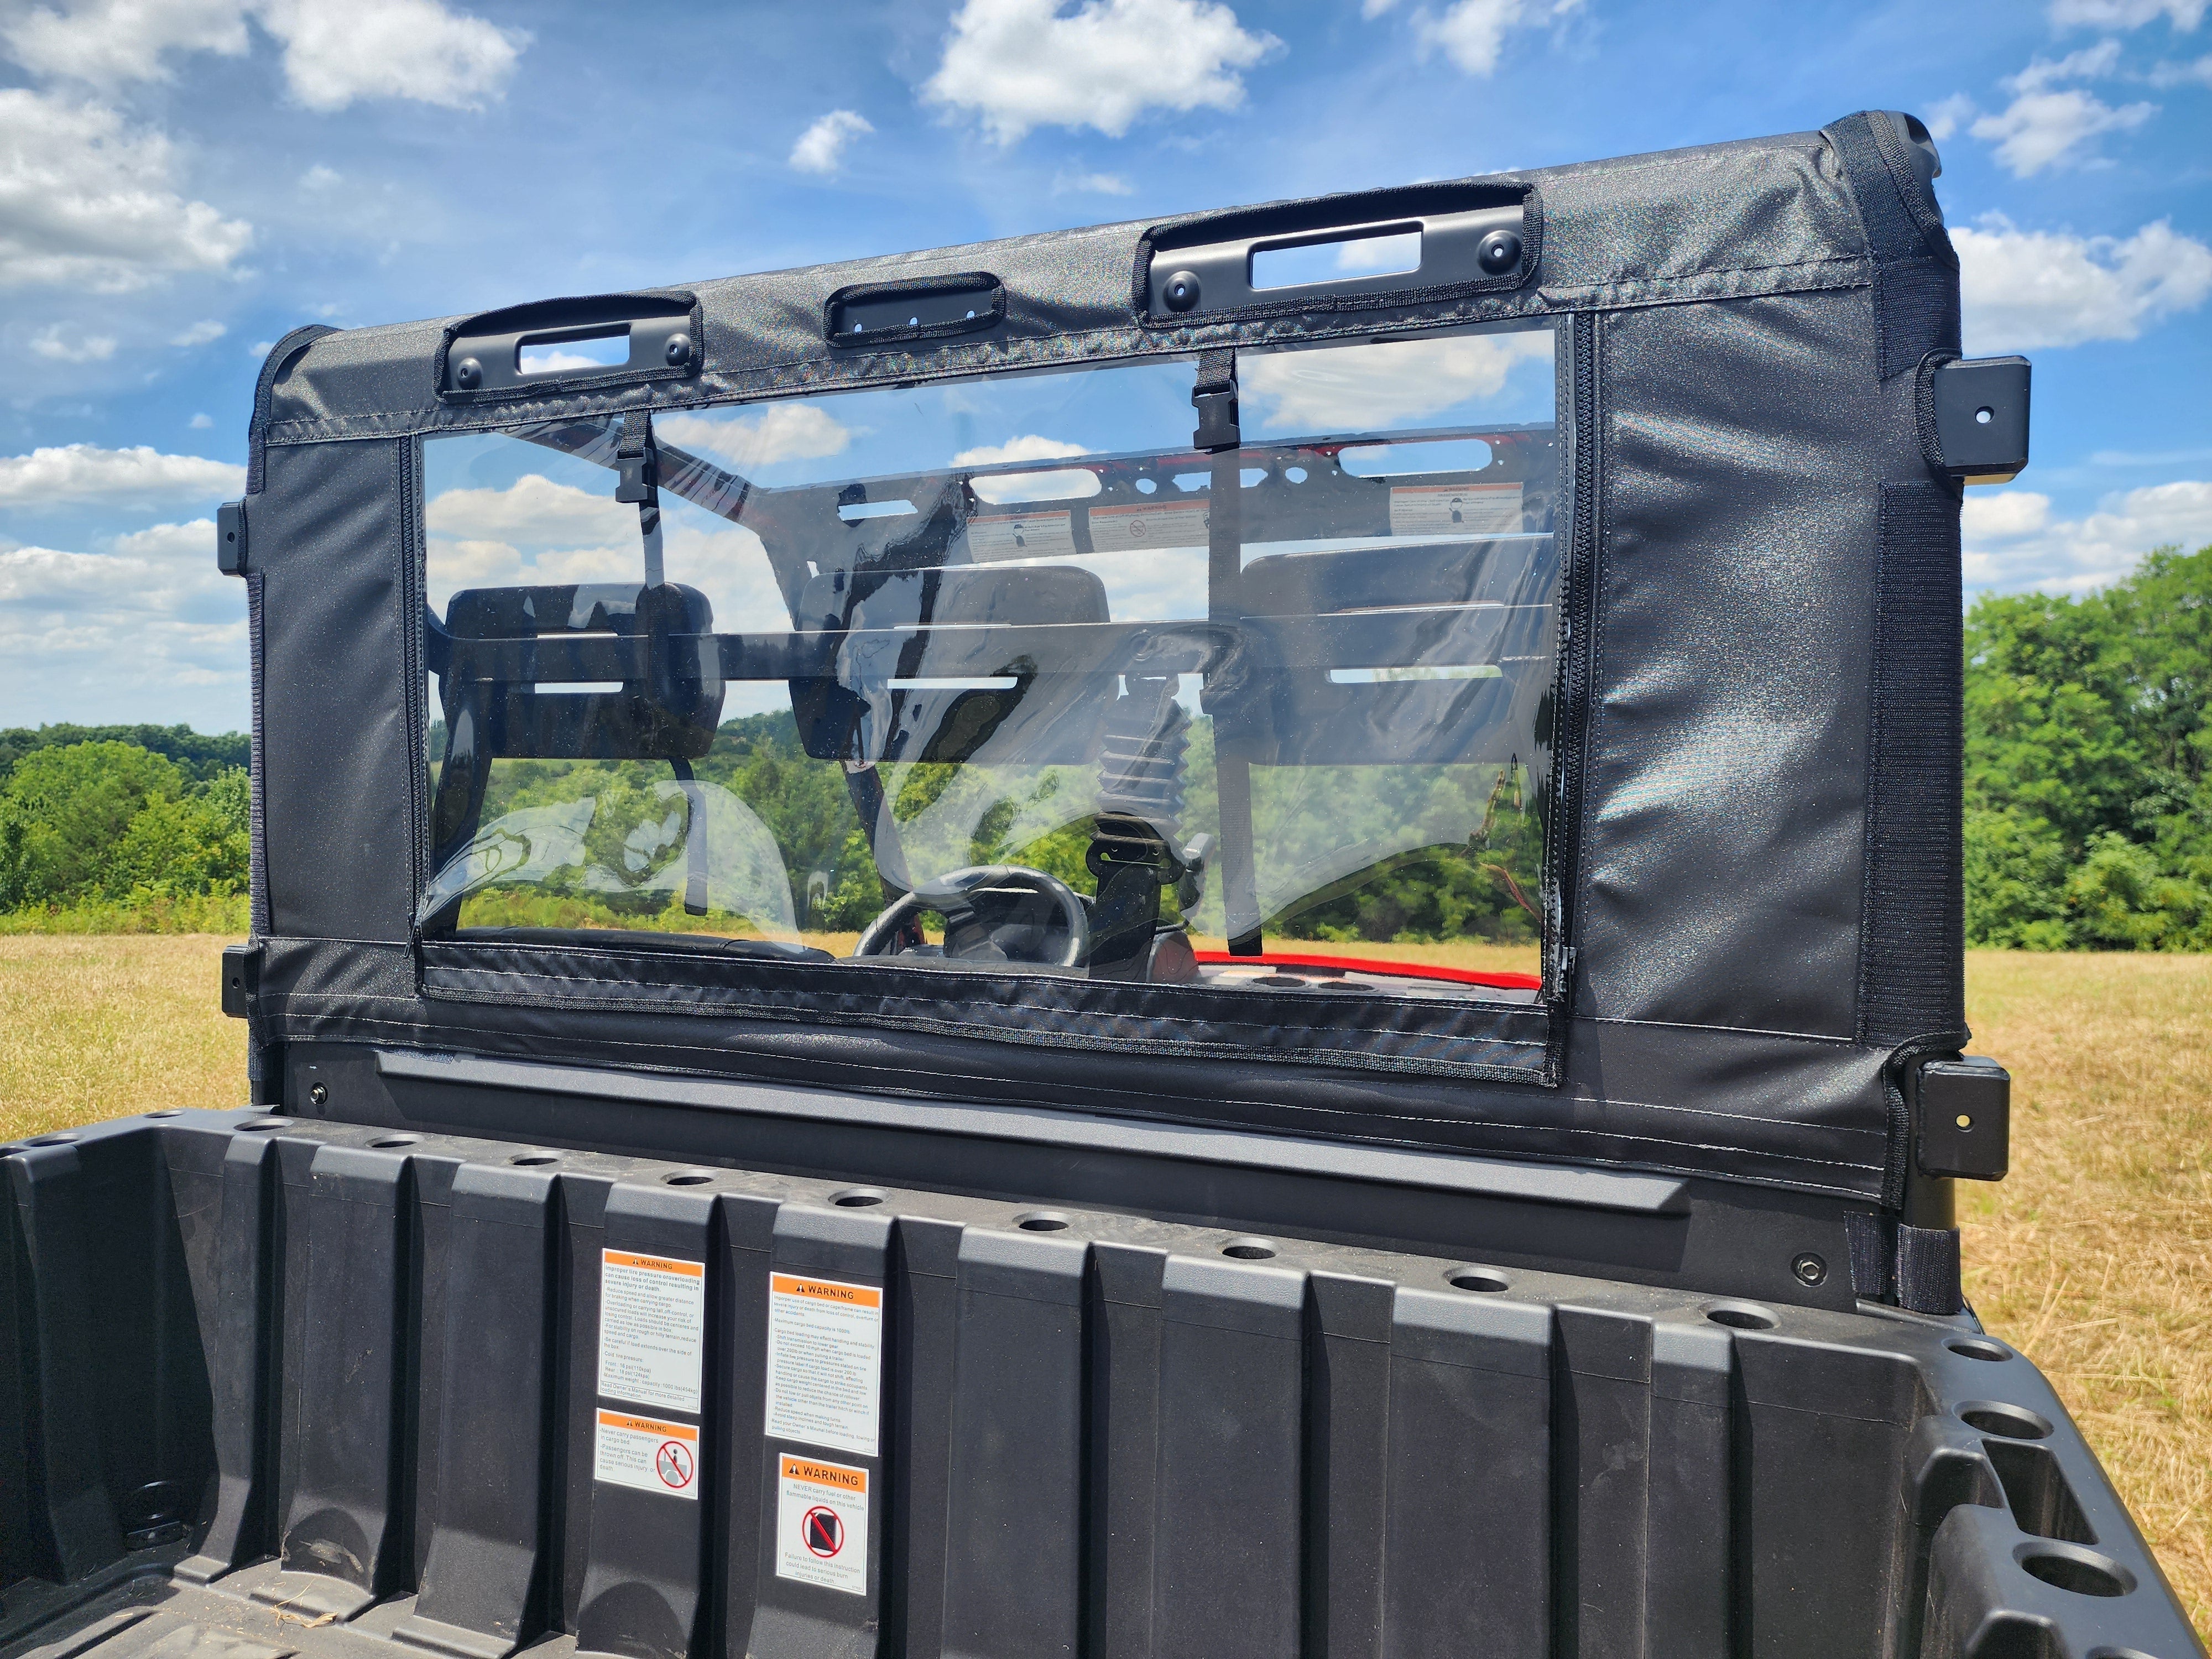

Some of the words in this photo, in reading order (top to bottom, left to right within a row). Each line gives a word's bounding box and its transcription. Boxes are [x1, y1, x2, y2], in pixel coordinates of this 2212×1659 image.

[605, 1265, 628, 1273] Improper
[640, 1259, 672, 1269] WARNING
[669, 1282, 692, 1291] resulting
[808, 1285, 854, 1300] WARNING
[635, 1421, 666, 1432] WARNING
[629, 1434, 658, 1443] passengers
[634, 1463, 648, 1472] injury
[803, 1466, 858, 1486] WARNING
[793, 1483, 812, 1492] NEVER
[786, 1490, 811, 1500] flammable
[785, 1552, 801, 1561] Failure
[808, 1557, 823, 1565] follow
[834, 1562, 860, 1573] instruction
[795, 1570, 813, 1579] injuries
[821, 1575, 836, 1584] death.
[817, 1568, 836, 1576] serious
